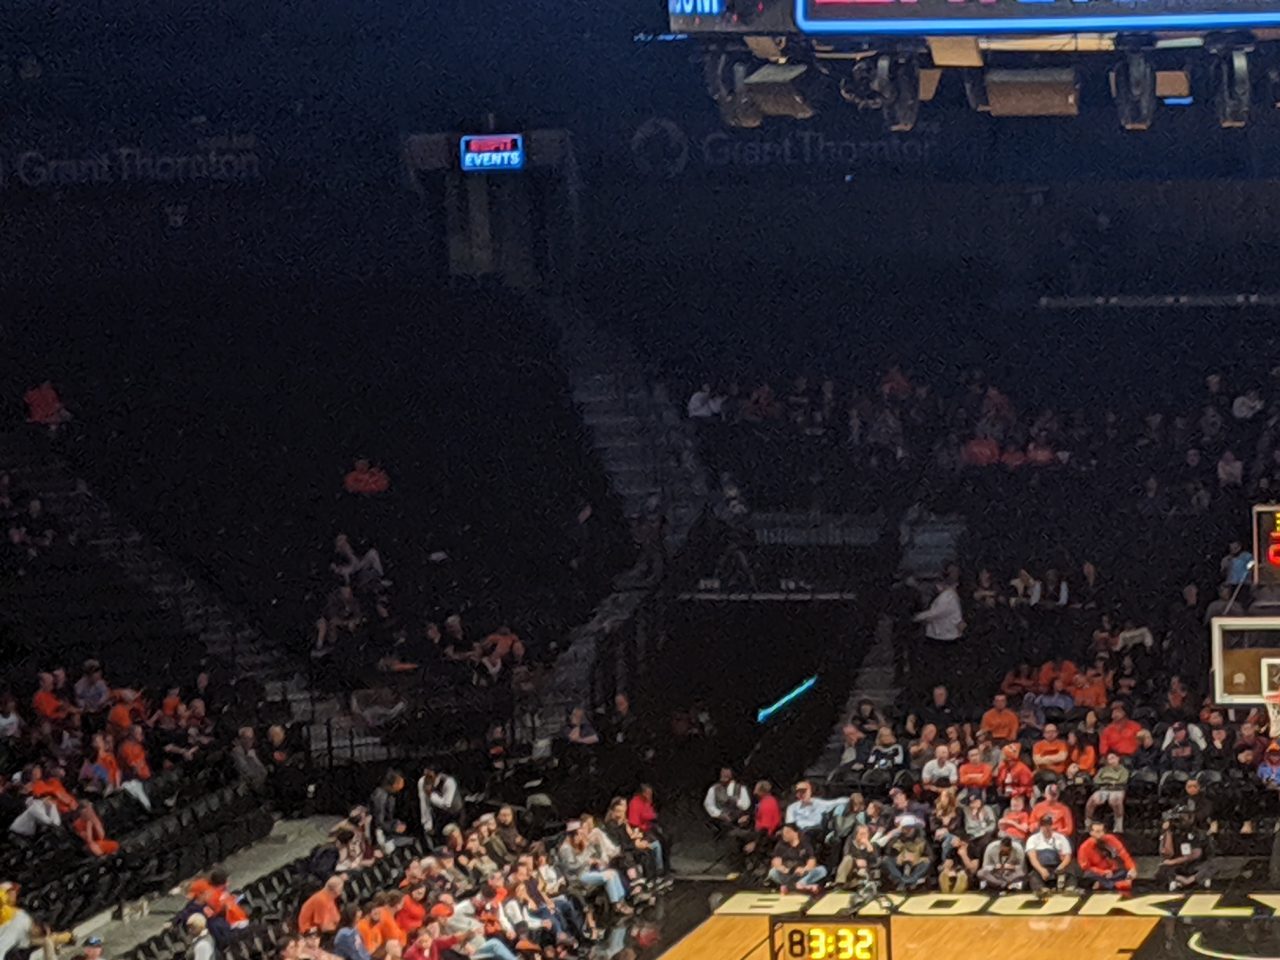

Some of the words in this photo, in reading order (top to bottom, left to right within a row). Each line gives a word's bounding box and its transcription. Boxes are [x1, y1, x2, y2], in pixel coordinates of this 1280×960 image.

[464, 152, 520, 167] EVENTS
[701, 131, 797, 164] Grant
[18, 150, 113, 186] Grant
[116, 146, 261, 182] Thornton
[809, 928, 874, 960] 3:32
